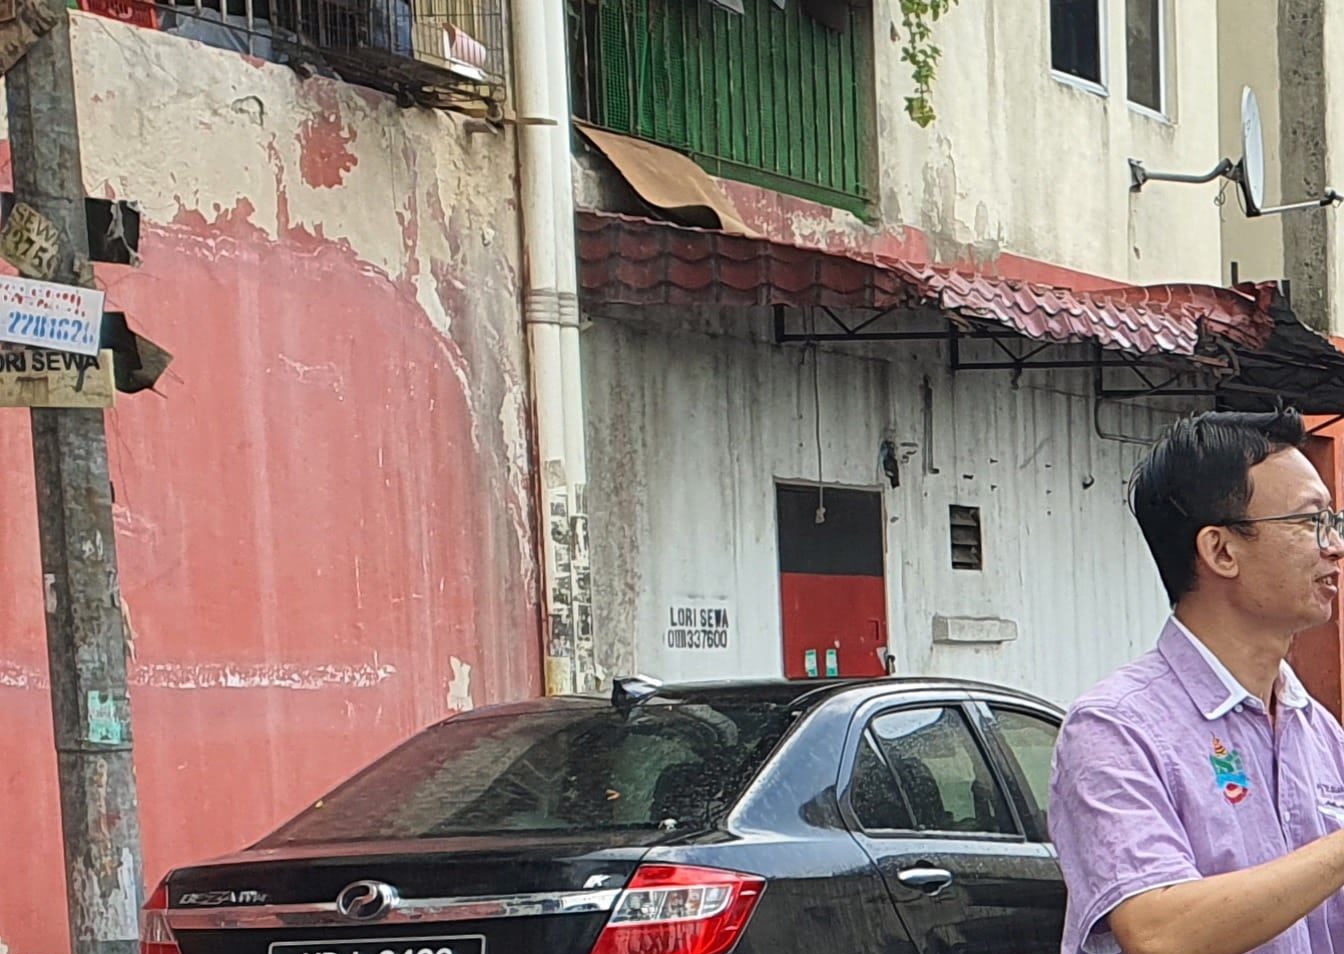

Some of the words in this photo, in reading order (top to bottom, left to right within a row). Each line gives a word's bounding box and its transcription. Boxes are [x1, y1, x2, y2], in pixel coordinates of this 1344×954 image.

[31, 350, 100, 372] SEWA
[669, 605, 698, 628] LORI
[699, 607, 729, 629] SEWA
